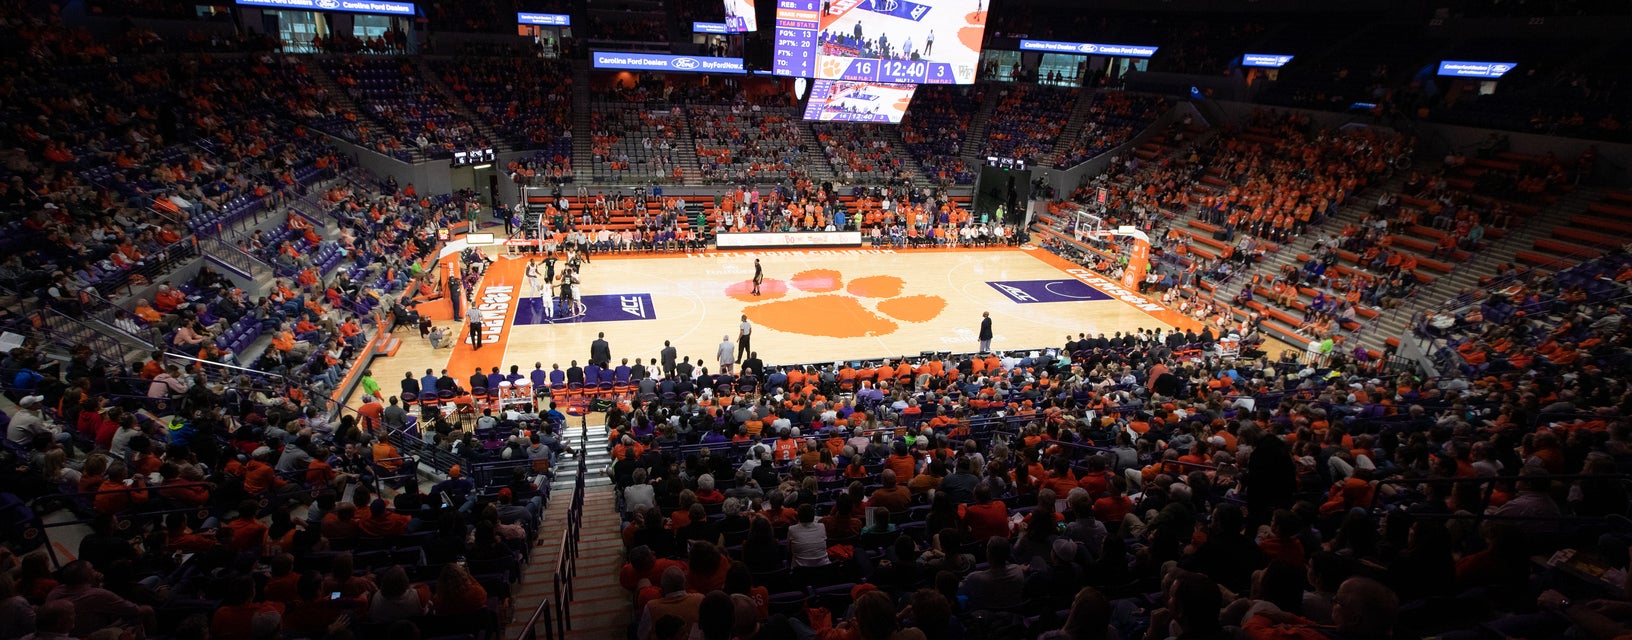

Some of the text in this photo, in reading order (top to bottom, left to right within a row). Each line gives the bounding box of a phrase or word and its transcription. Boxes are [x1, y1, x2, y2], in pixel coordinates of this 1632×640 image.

[343, 1, 370, 10] Carolina
[386, 4, 410, 12] Dealers
[781, 1, 797, 9] REB:
[778, 39, 811, 48] 3PT%: 20
[777, 49, 793, 57] FT%:
[599, 57, 627, 65] Carolina
[643, 58, 668, 66] Dealers
[675, 58, 695, 68] Ford
[855, 61, 872, 75] 16
[883, 61, 925, 78] 12:40
[936, 65, 945, 78] 3
[686, 250, 805, 258] LITTLEJOHN
[998, 283, 1039, 302] ACC
[1066, 268, 1165, 311] CLEMSON
[620, 295, 641, 317] ACC
[464, 285, 515, 344] CLEMSON
[783, 450, 790, 460] 2
